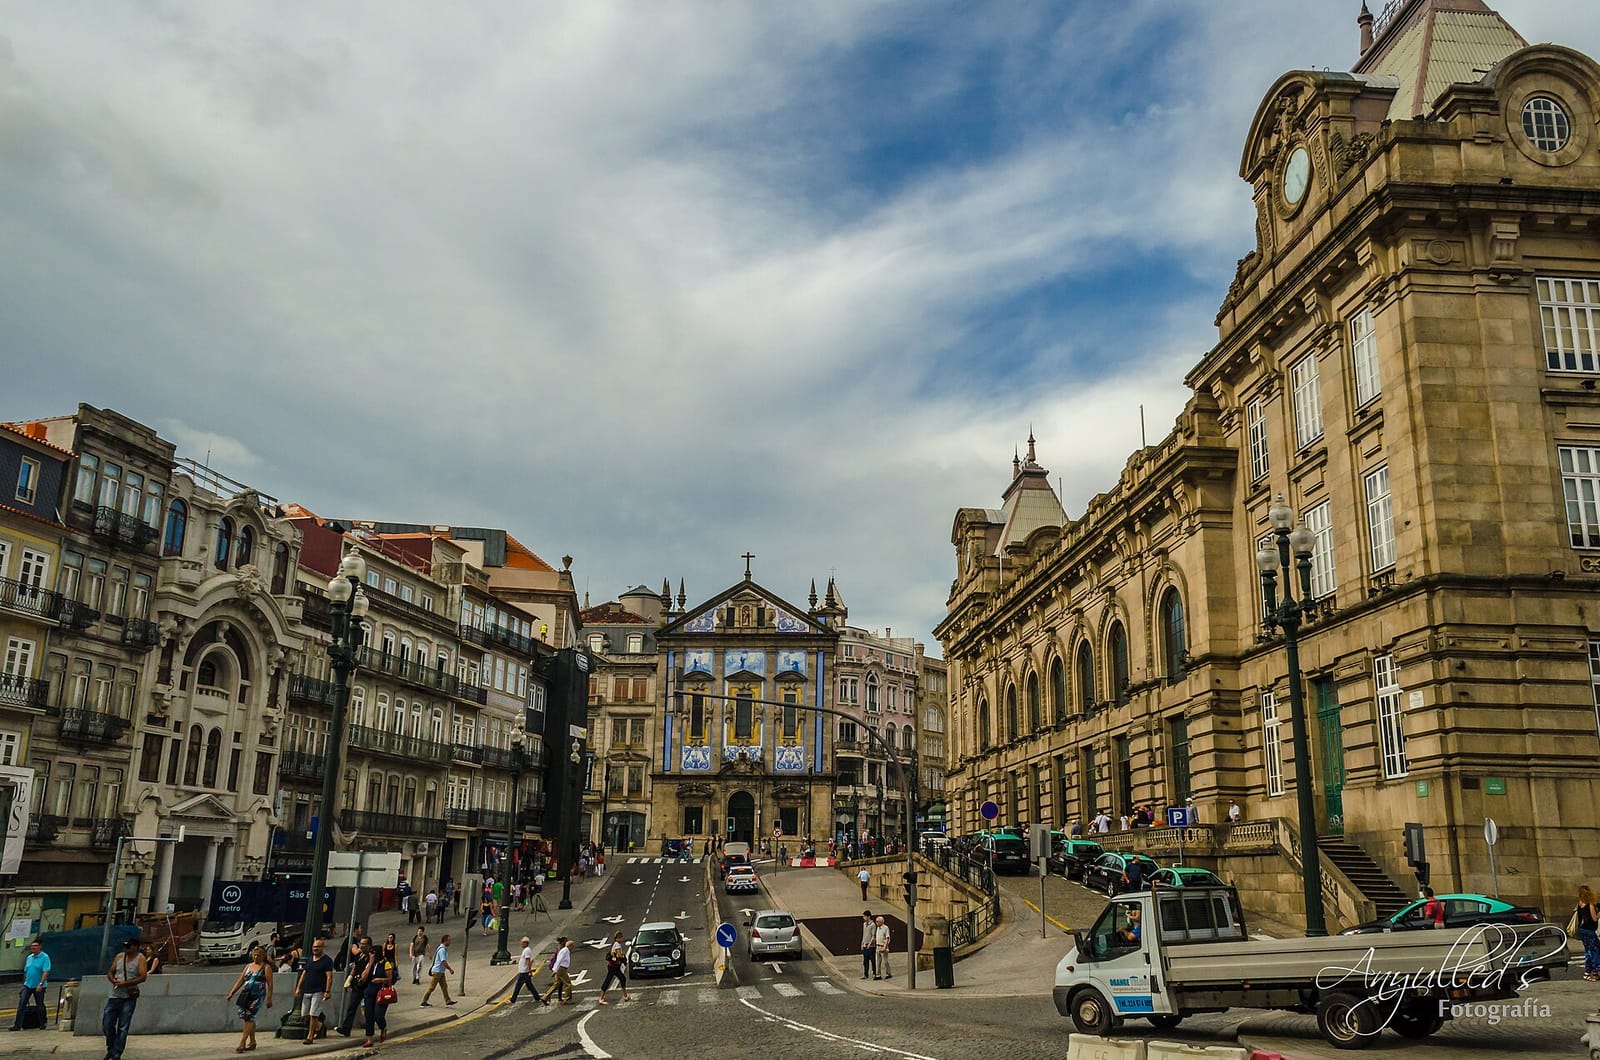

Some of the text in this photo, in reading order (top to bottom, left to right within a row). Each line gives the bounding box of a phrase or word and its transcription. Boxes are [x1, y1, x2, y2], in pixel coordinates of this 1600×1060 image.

[1173, 811, 1183, 824] P
[289, 890, 305, 899] São
[218, 904, 241, 912] metro
